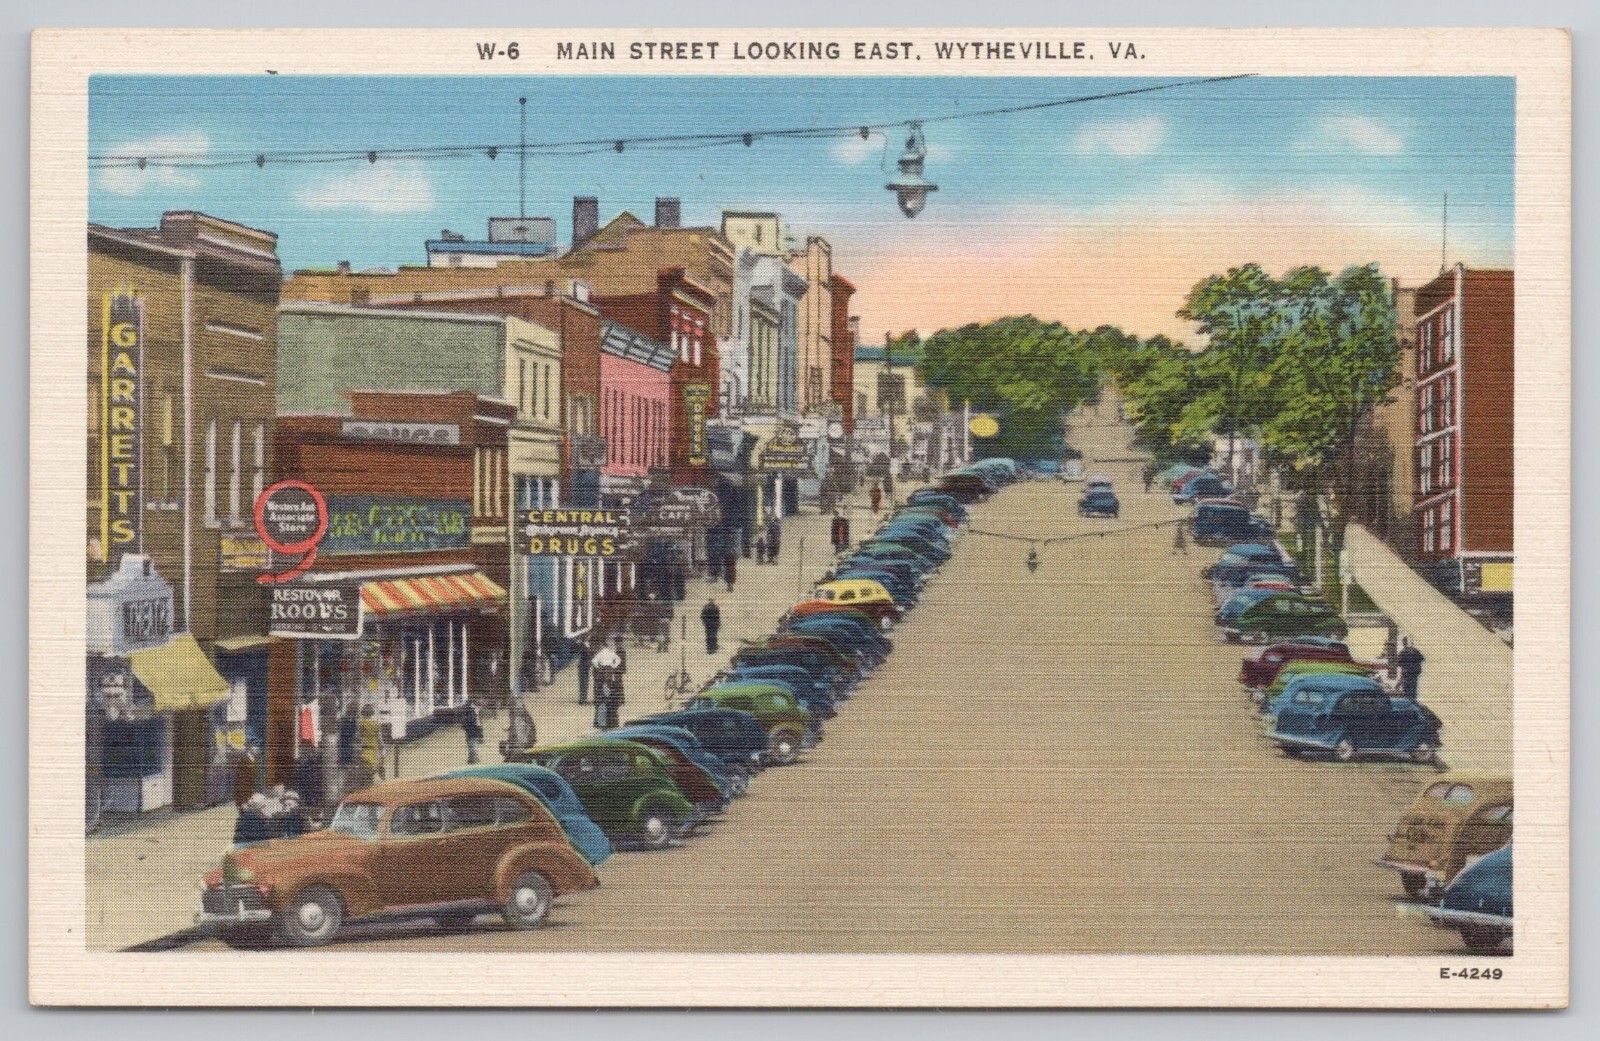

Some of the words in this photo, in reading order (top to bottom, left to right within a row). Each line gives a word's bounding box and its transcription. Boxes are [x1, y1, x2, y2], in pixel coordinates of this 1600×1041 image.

[110, 319, 137, 544] GARRETTS
[528, 510, 616, 523] CENTRAL
[529, 537, 615, 555] DRUGS
